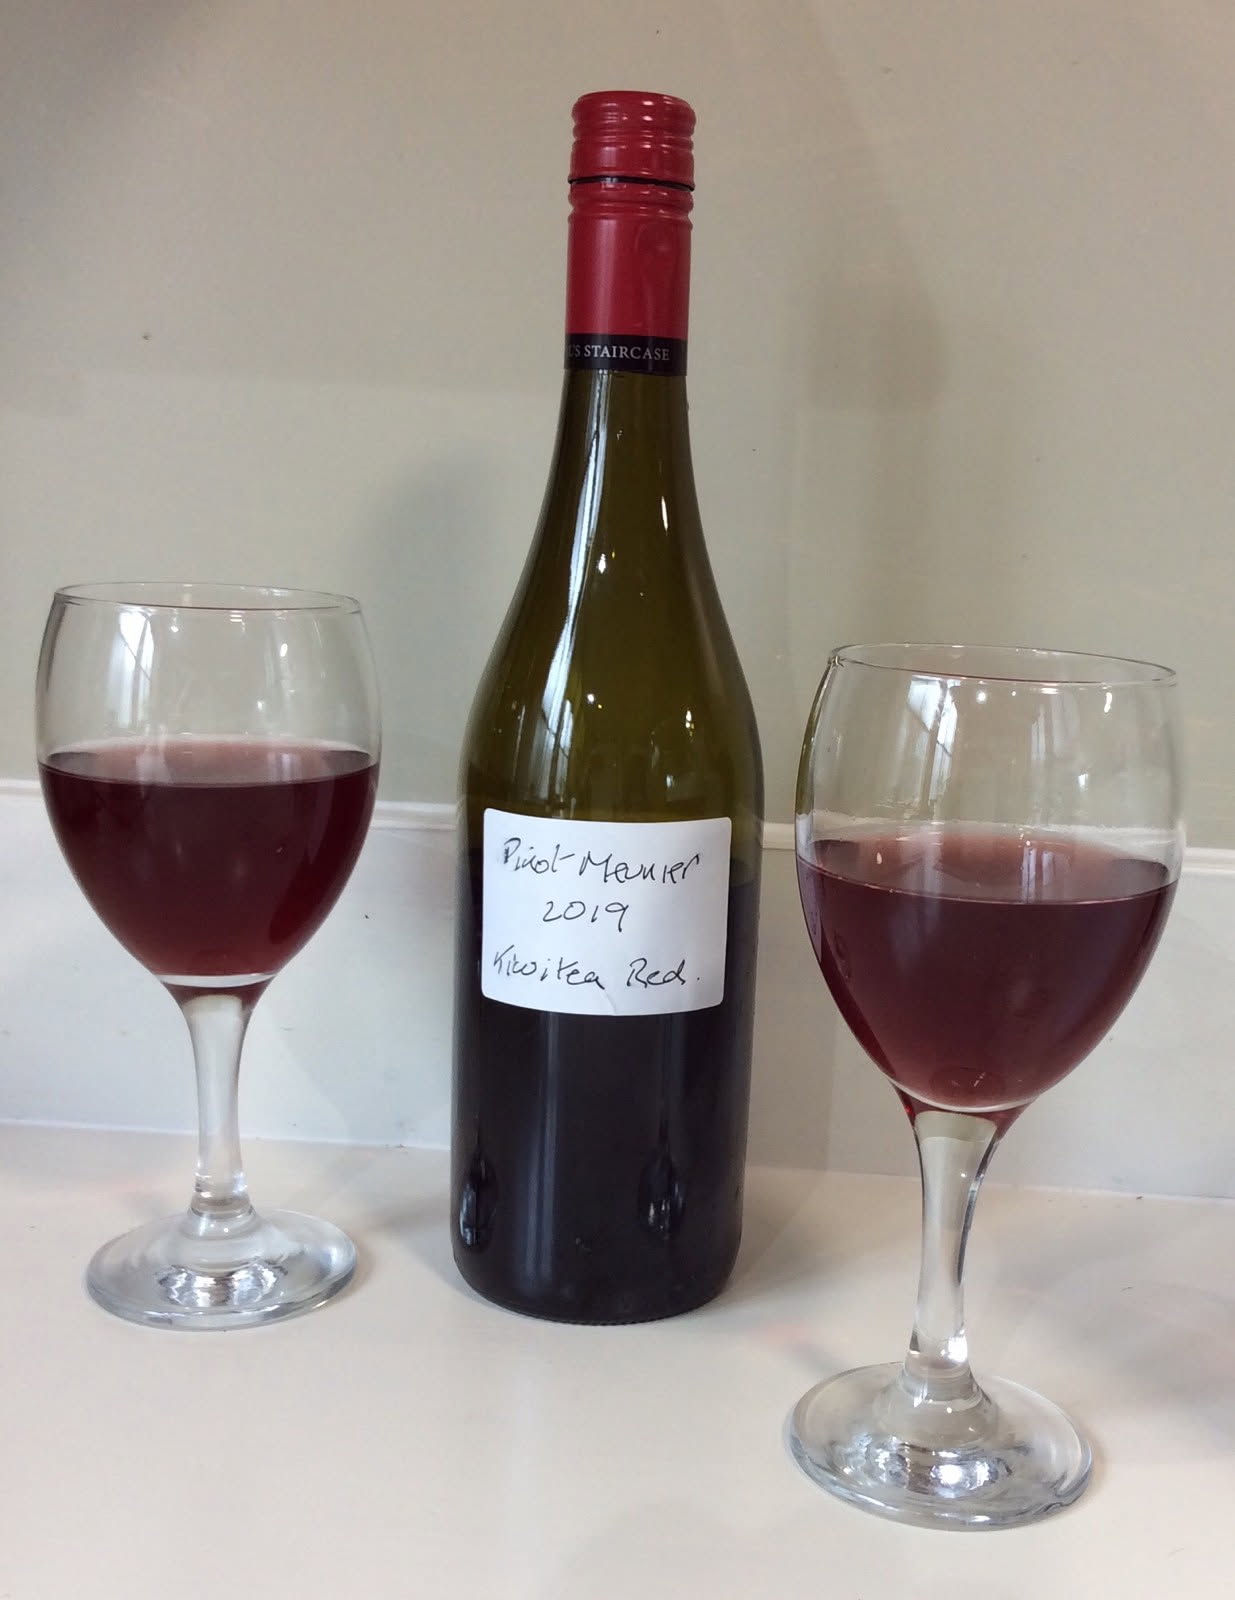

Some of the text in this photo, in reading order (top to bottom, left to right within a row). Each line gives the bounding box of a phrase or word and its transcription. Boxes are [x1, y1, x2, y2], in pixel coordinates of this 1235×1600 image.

[584, 344, 670, 361] STAIRCASE
[503, 837, 700, 884] Pinot Meunier
[542, 901, 629, 932] 2019
